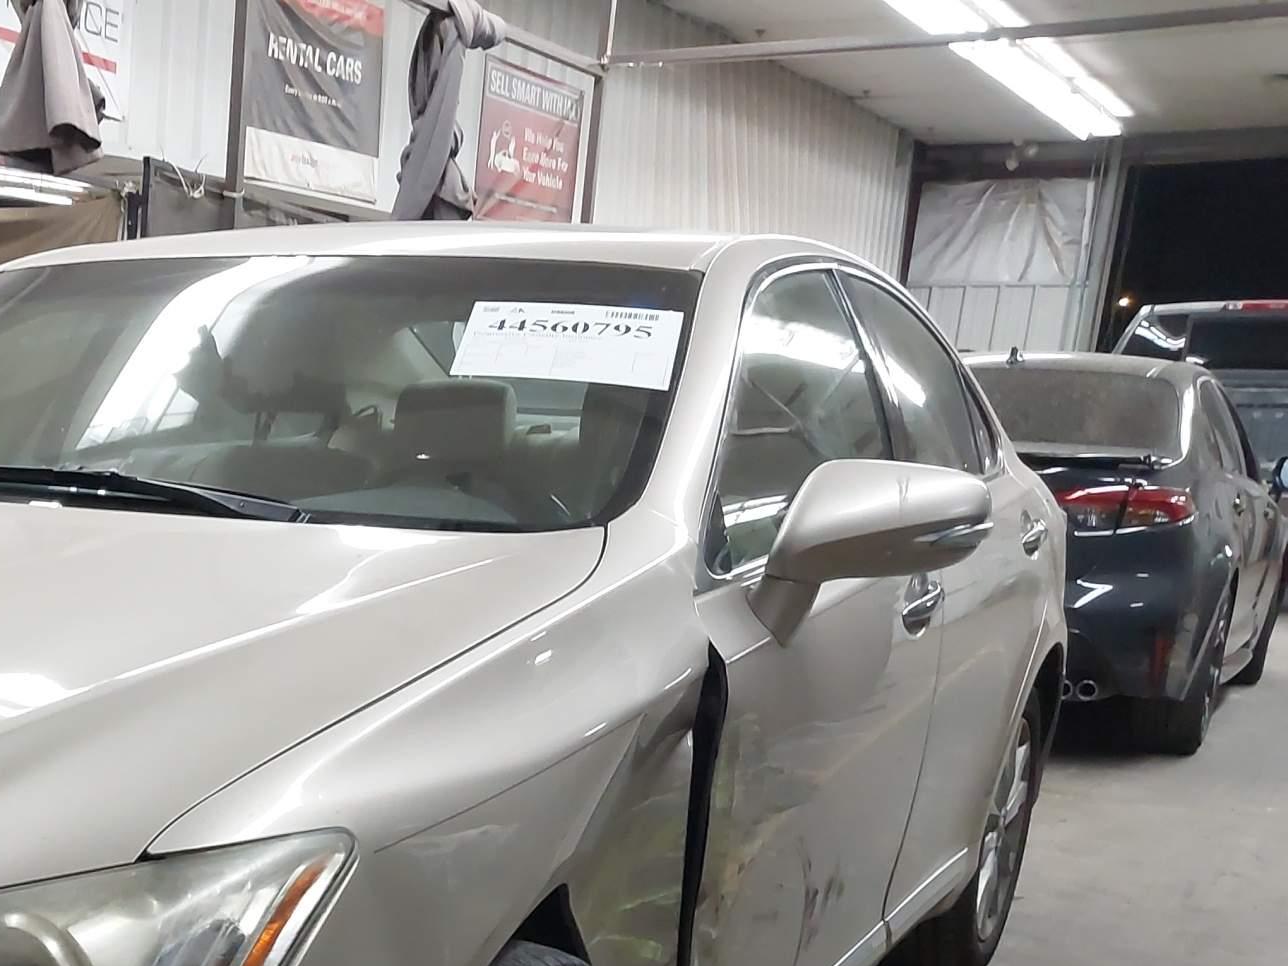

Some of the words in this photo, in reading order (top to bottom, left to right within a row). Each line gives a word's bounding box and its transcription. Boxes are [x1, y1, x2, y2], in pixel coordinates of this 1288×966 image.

[268, 31, 322, 73] RENTAL
[326, 51, 362, 85] CARS
[490, 69, 510, 98] SELL
[511, 77, 542, 108] SMART
[488, 318, 653, 340] 44560795
